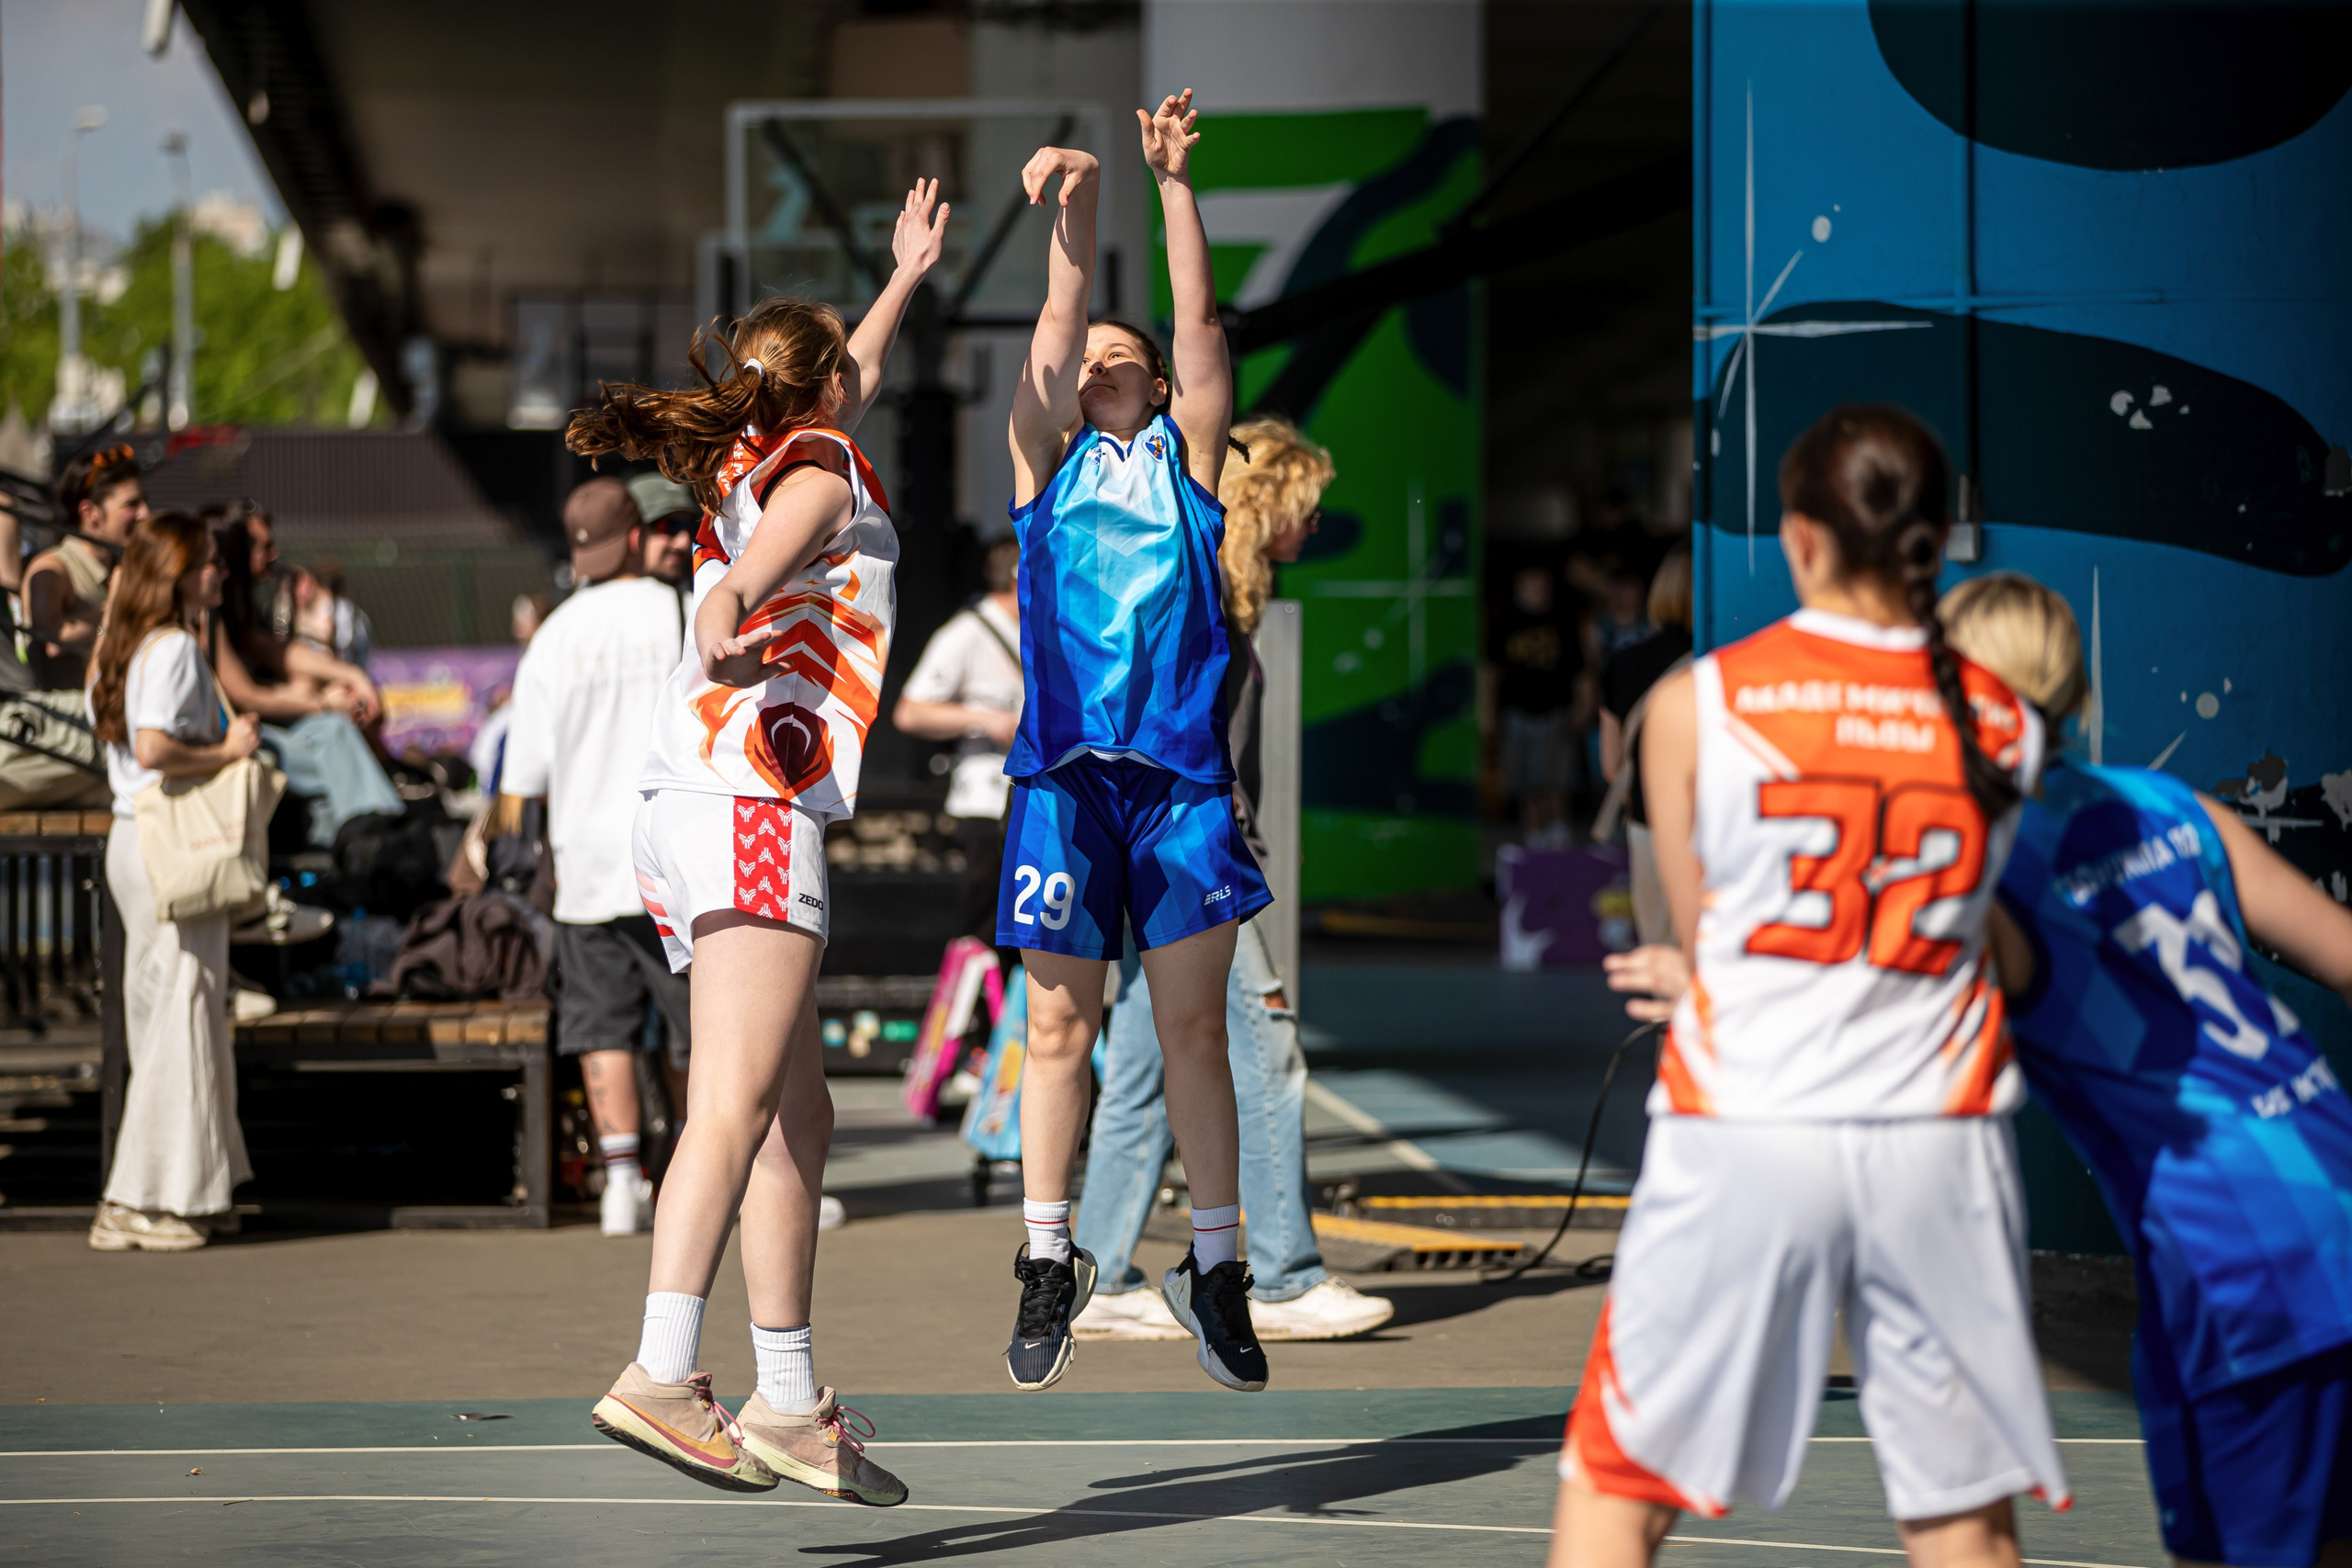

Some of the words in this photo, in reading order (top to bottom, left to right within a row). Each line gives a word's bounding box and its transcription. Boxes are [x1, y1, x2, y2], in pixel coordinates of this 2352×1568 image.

[798, 892, 824, 911] ZEDO
[1014, 864, 1076, 931] 29
[1743, 776, 1988, 979] 32
